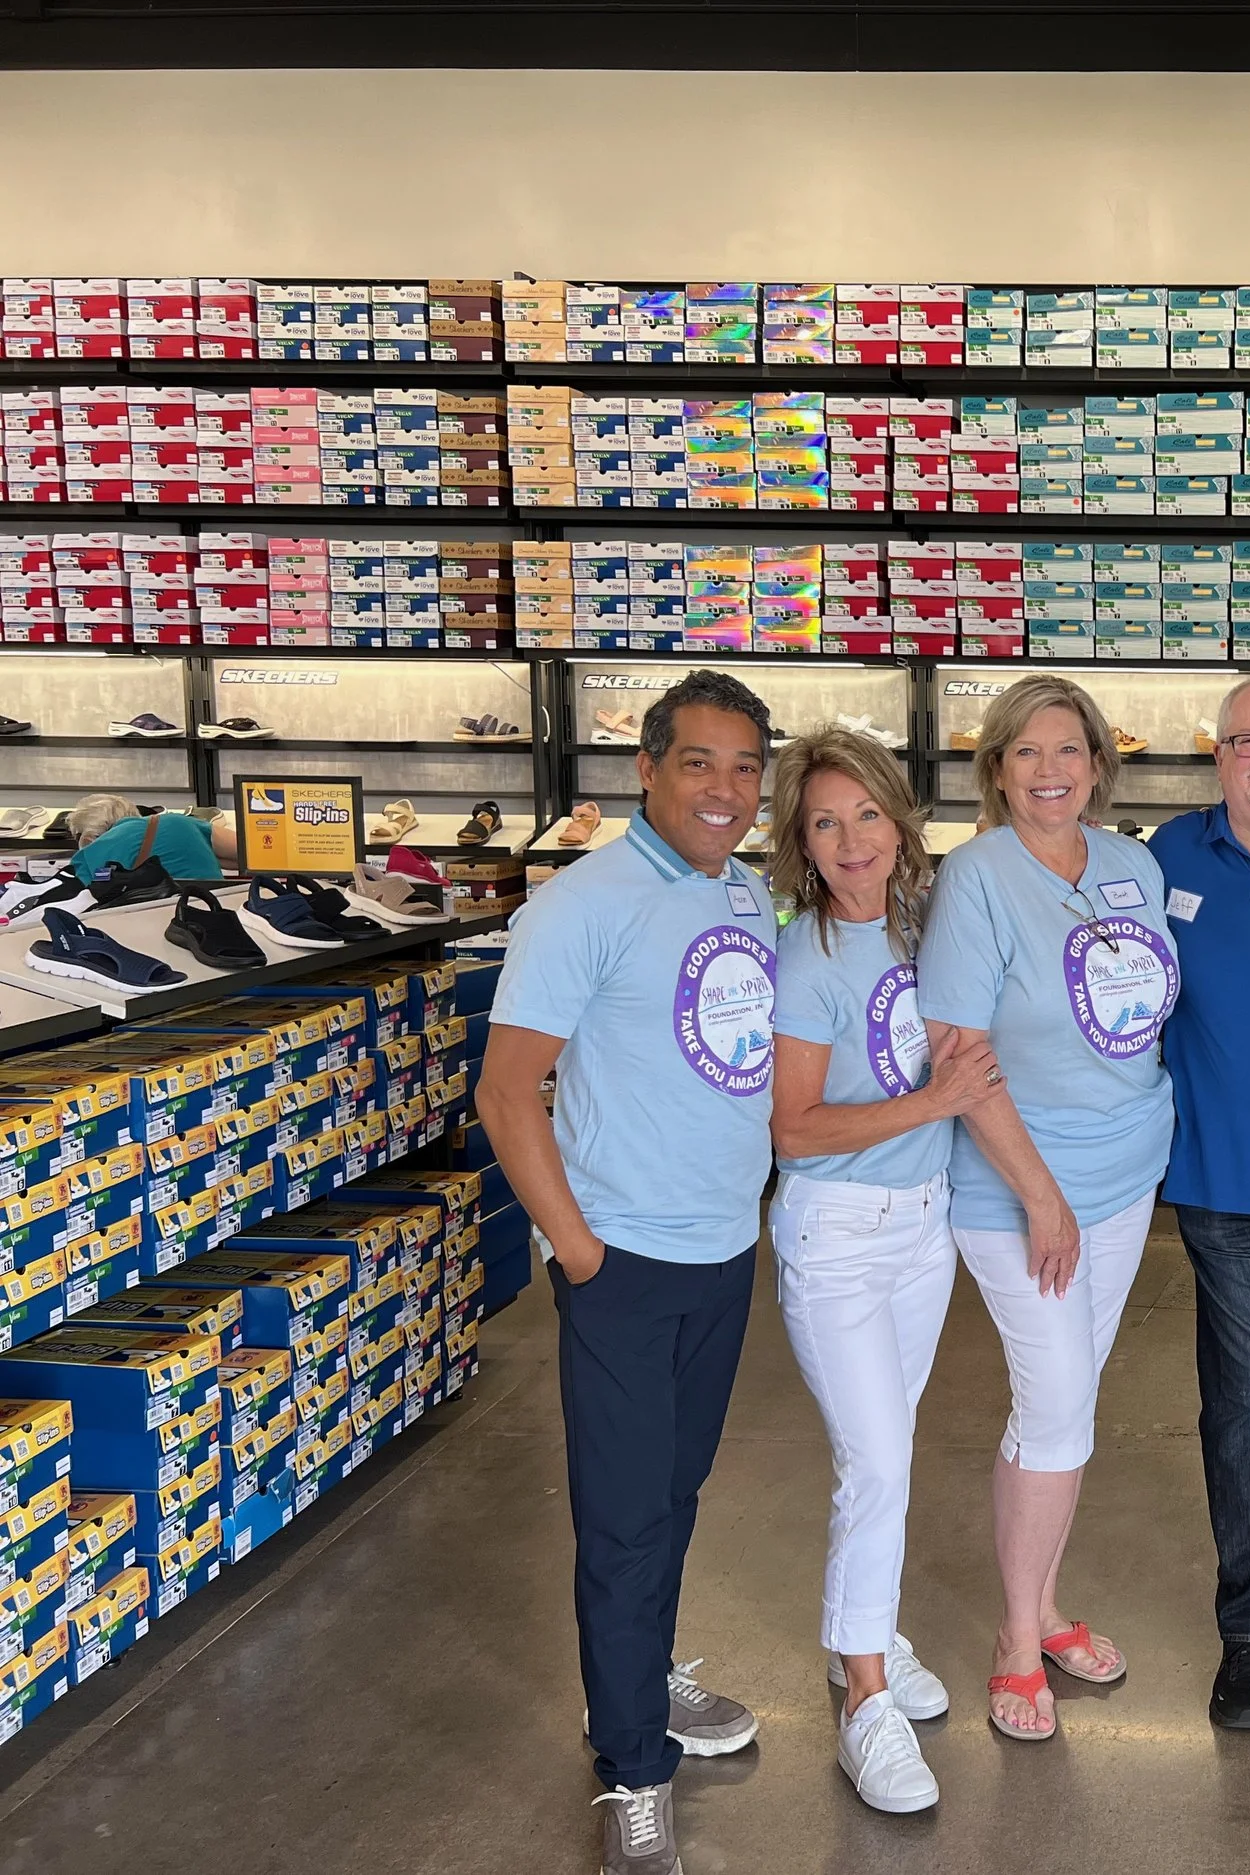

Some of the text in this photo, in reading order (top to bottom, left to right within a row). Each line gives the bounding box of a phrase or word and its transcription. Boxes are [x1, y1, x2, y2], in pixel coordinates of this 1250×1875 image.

[220, 669, 338, 685] SKECHERS
[944, 681, 1010, 696] SKEC
[292, 790, 352, 798] SKECHERS
[295, 807, 349, 825] Slip-ins
[1097, 922, 1153, 944] SHOES
[685, 932, 769, 979] GOOD SHOES
[1099, 981, 1142, 992] FOUNDATION,
[872, 978, 897, 1023] GOOD
[708, 1005, 753, 1020] FOUNDATION,
[1074, 982, 1091, 1025] TAKE
[1088, 1024, 1107, 1049] YOU
[682, 1008, 701, 1054] TAKE
[697, 1053, 725, 1083] YOU
[876, 1049, 898, 1087] TAKE
